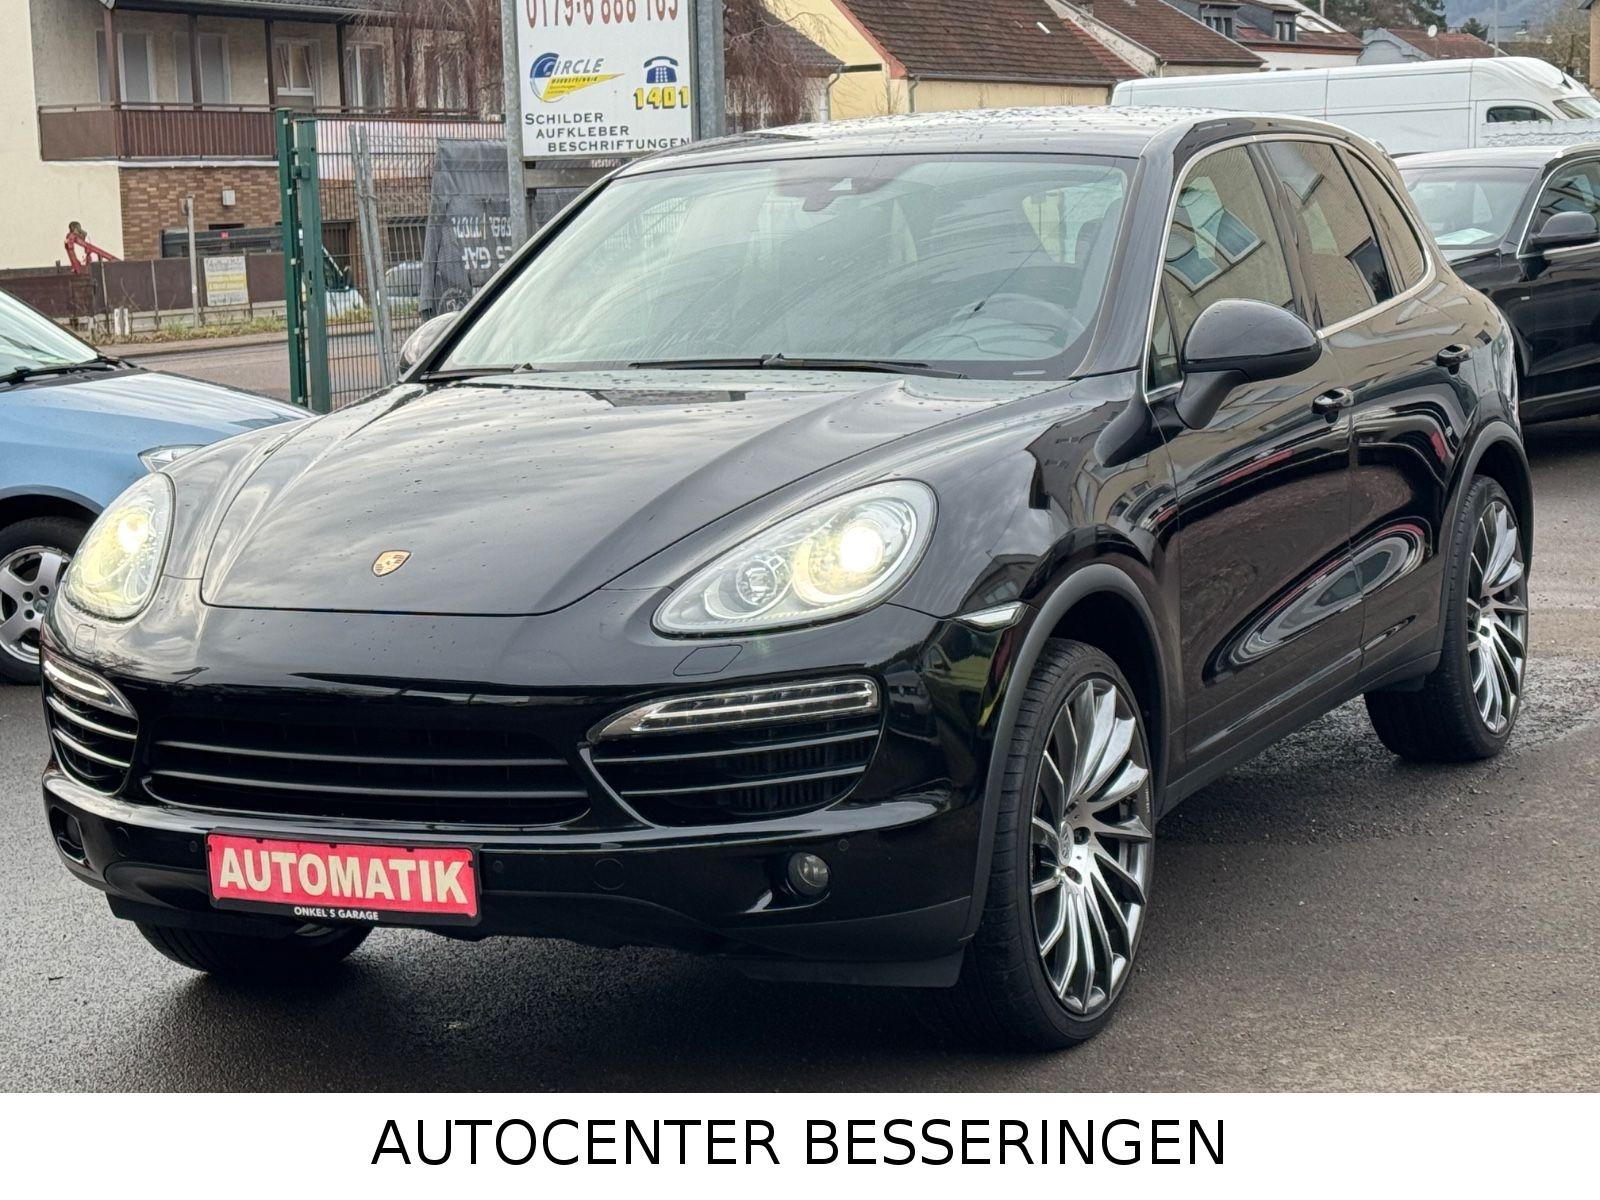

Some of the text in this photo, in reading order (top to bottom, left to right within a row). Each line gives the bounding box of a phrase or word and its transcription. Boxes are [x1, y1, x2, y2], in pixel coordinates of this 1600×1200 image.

[530, 53, 605, 84] CIRCLE
[633, 86, 689, 110] 1401
[525, 112, 604, 125] SCHILDER
[536, 125, 630, 139] AUFKLEBER
[548, 138, 690, 153] BESCHRIFTUNGEN
[219, 847, 468, 904] AUTOMATIK
[337, 909, 379, 921] GARAGE
